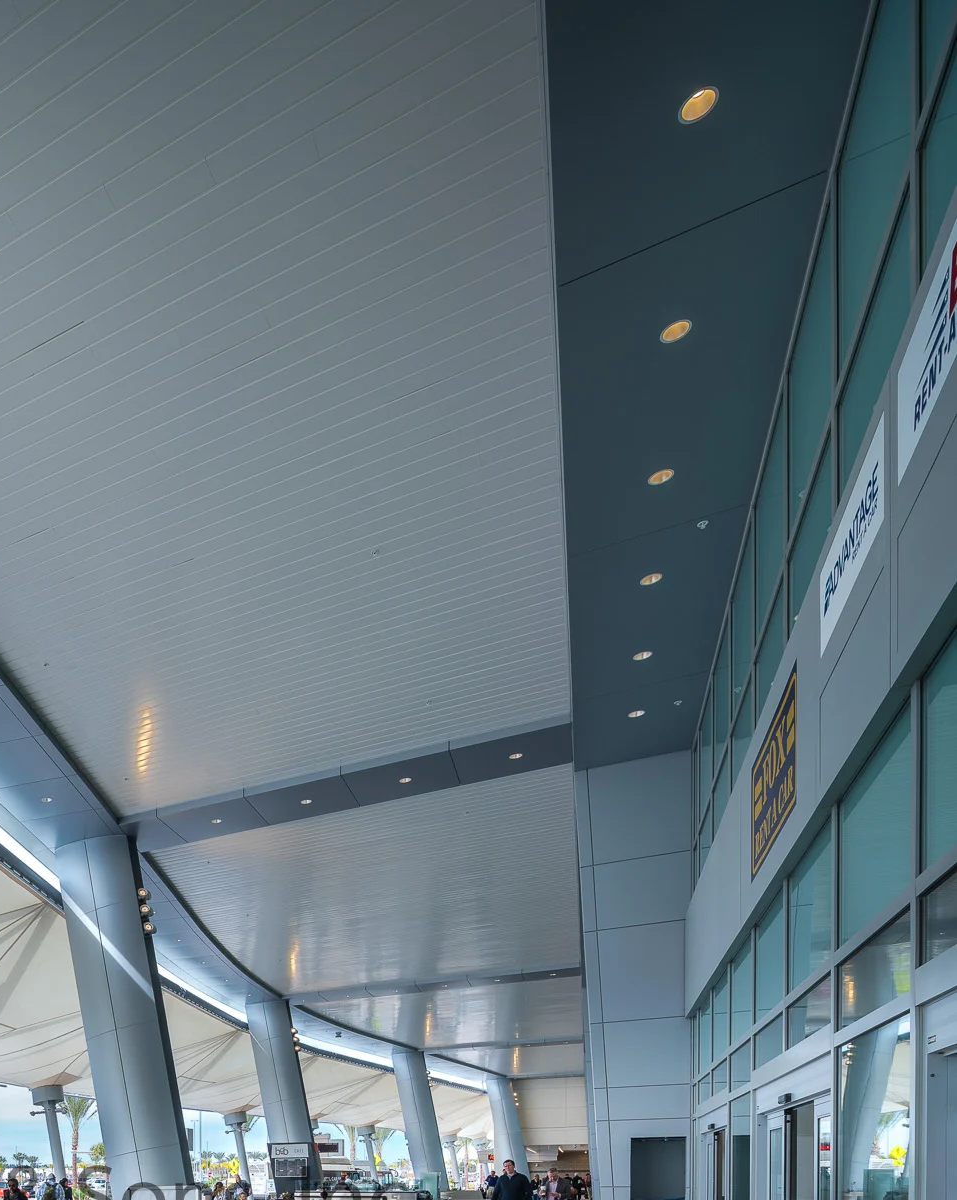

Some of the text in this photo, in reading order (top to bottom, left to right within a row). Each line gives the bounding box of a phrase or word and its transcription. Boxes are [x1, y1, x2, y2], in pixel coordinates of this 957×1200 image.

[823, 460, 879, 618] ADVANTAGE
[762, 714, 786, 804] FOX
[755, 764, 794, 859] RENT A CAR
